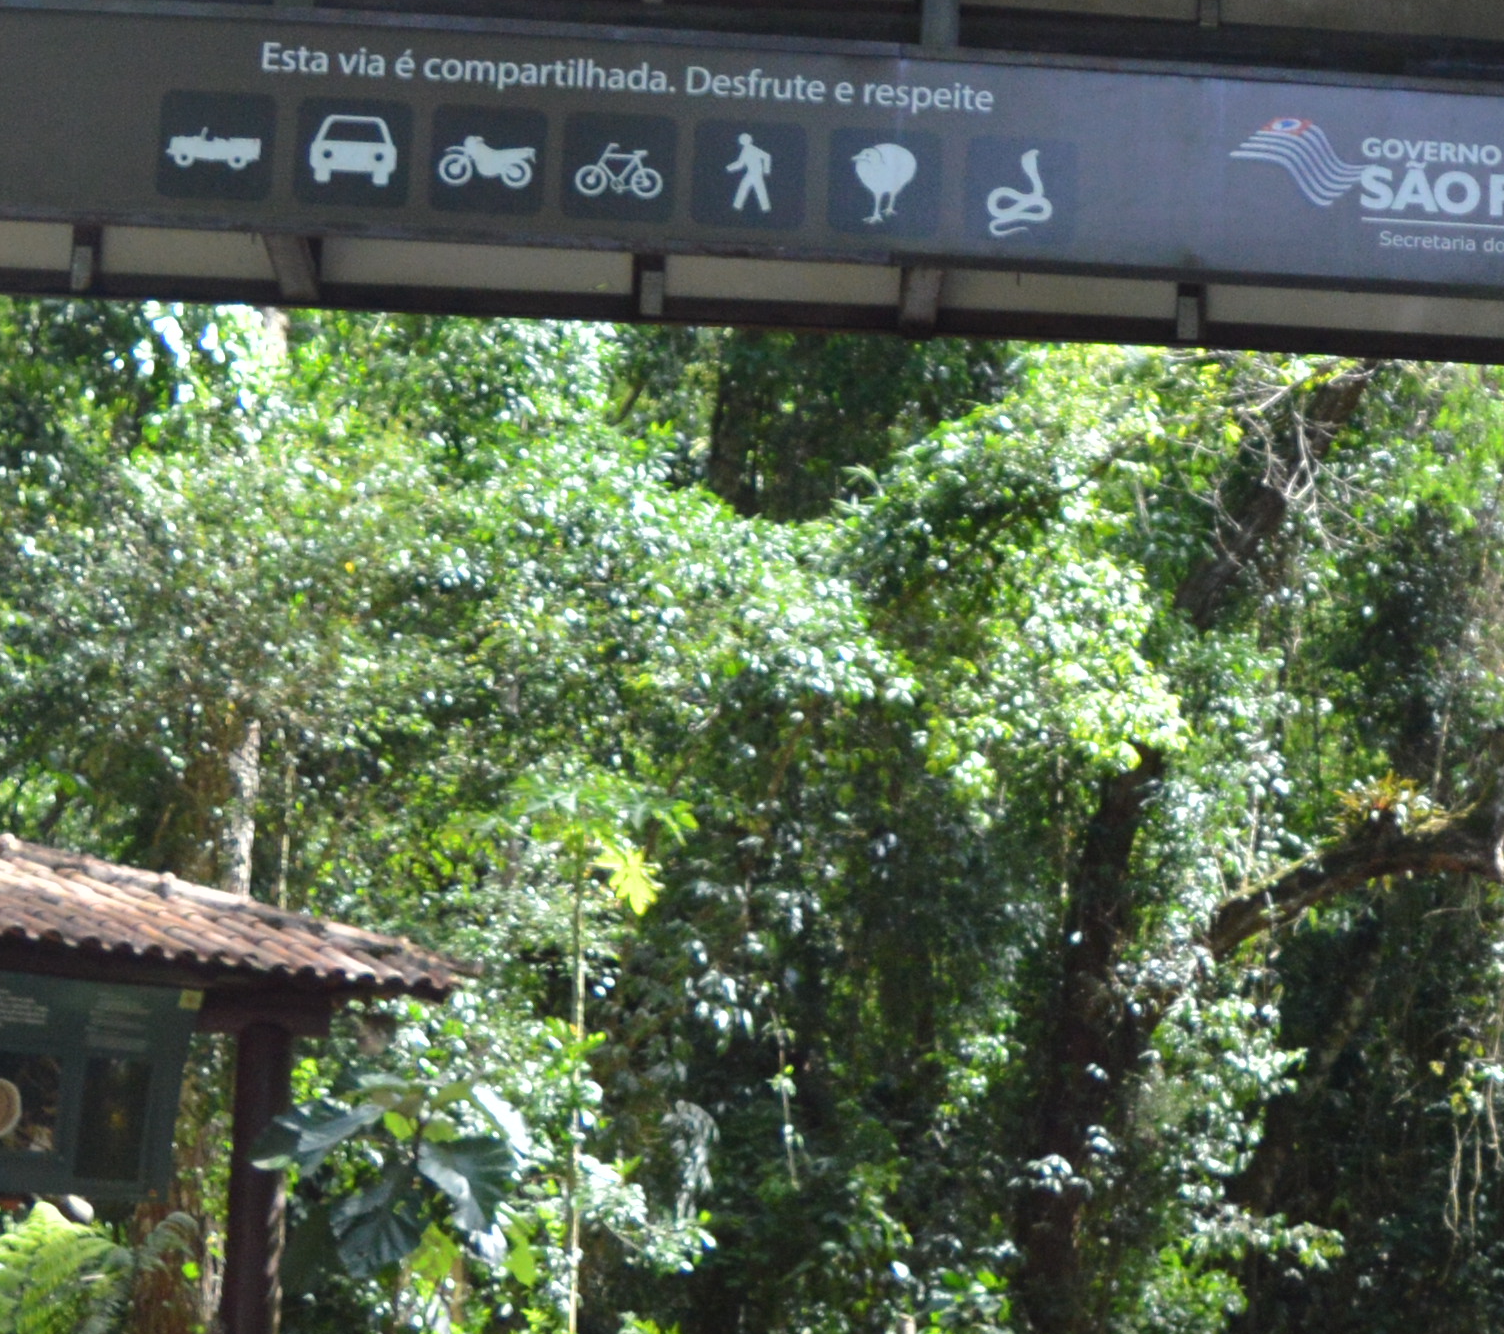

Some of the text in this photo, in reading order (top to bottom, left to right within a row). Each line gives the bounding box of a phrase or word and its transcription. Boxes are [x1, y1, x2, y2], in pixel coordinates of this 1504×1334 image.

[261, 41, 995, 115] Esta via é compartilhada. Desfrute e respeite
[1361, 137, 1503, 168] GOVERNO
[1359, 160, 1481, 215] SÃO
[1378, 229, 1477, 252] Secretaria
